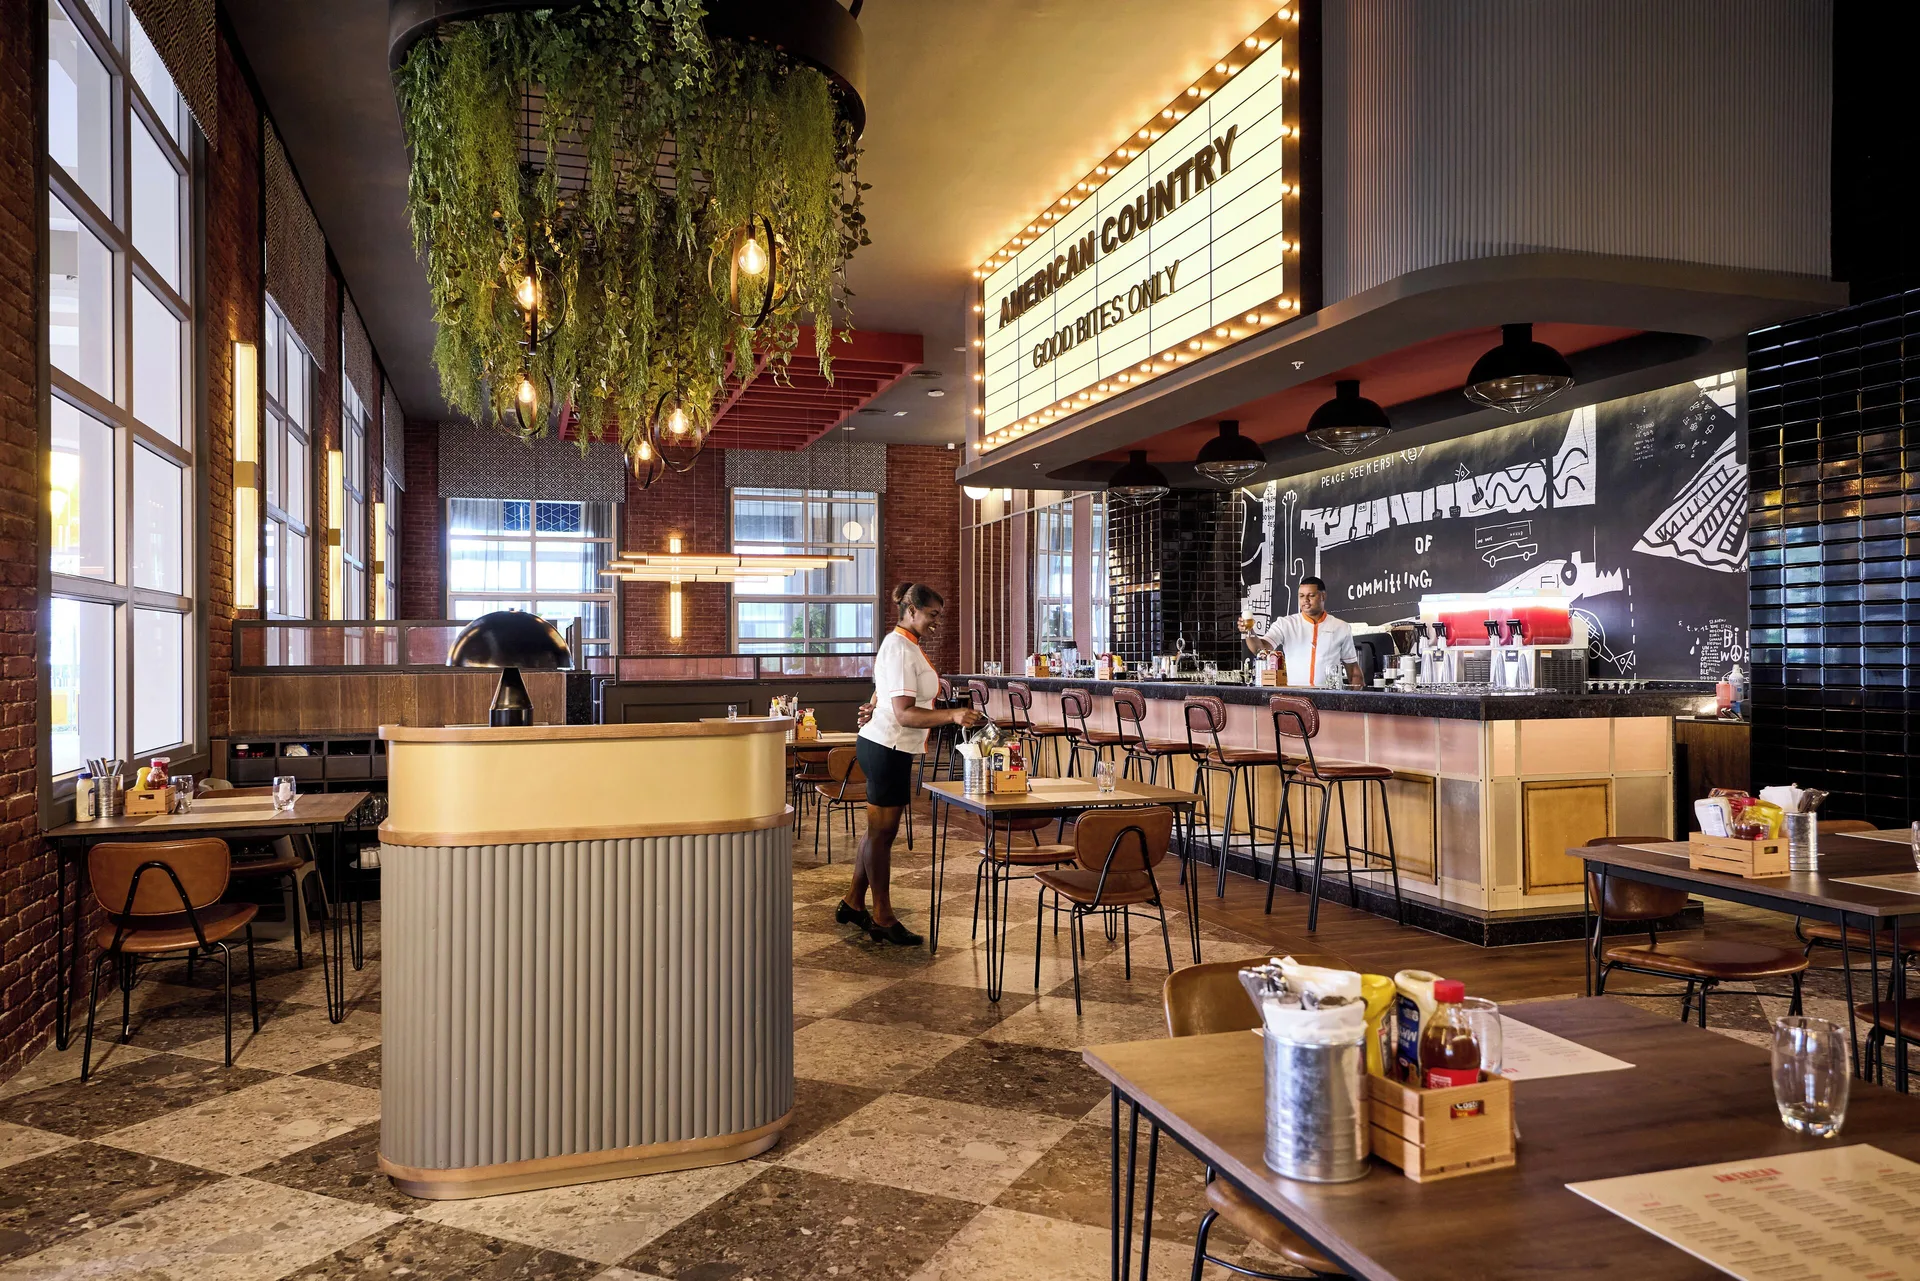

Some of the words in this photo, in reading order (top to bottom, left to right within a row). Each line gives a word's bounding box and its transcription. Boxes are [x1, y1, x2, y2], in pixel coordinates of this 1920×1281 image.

[999, 229, 1096, 329] AMERICAN
[1100, 124, 1239, 254] COUNTRY
[1032, 323, 1074, 370] GOOD
[1075, 294, 1124, 345] BITES
[1127, 258, 1180, 316] ONLY
[1321, 471, 1346, 489] PEACE
[1349, 454, 1395, 479] SEEKERS!
[1414, 534, 1433, 555] OF
